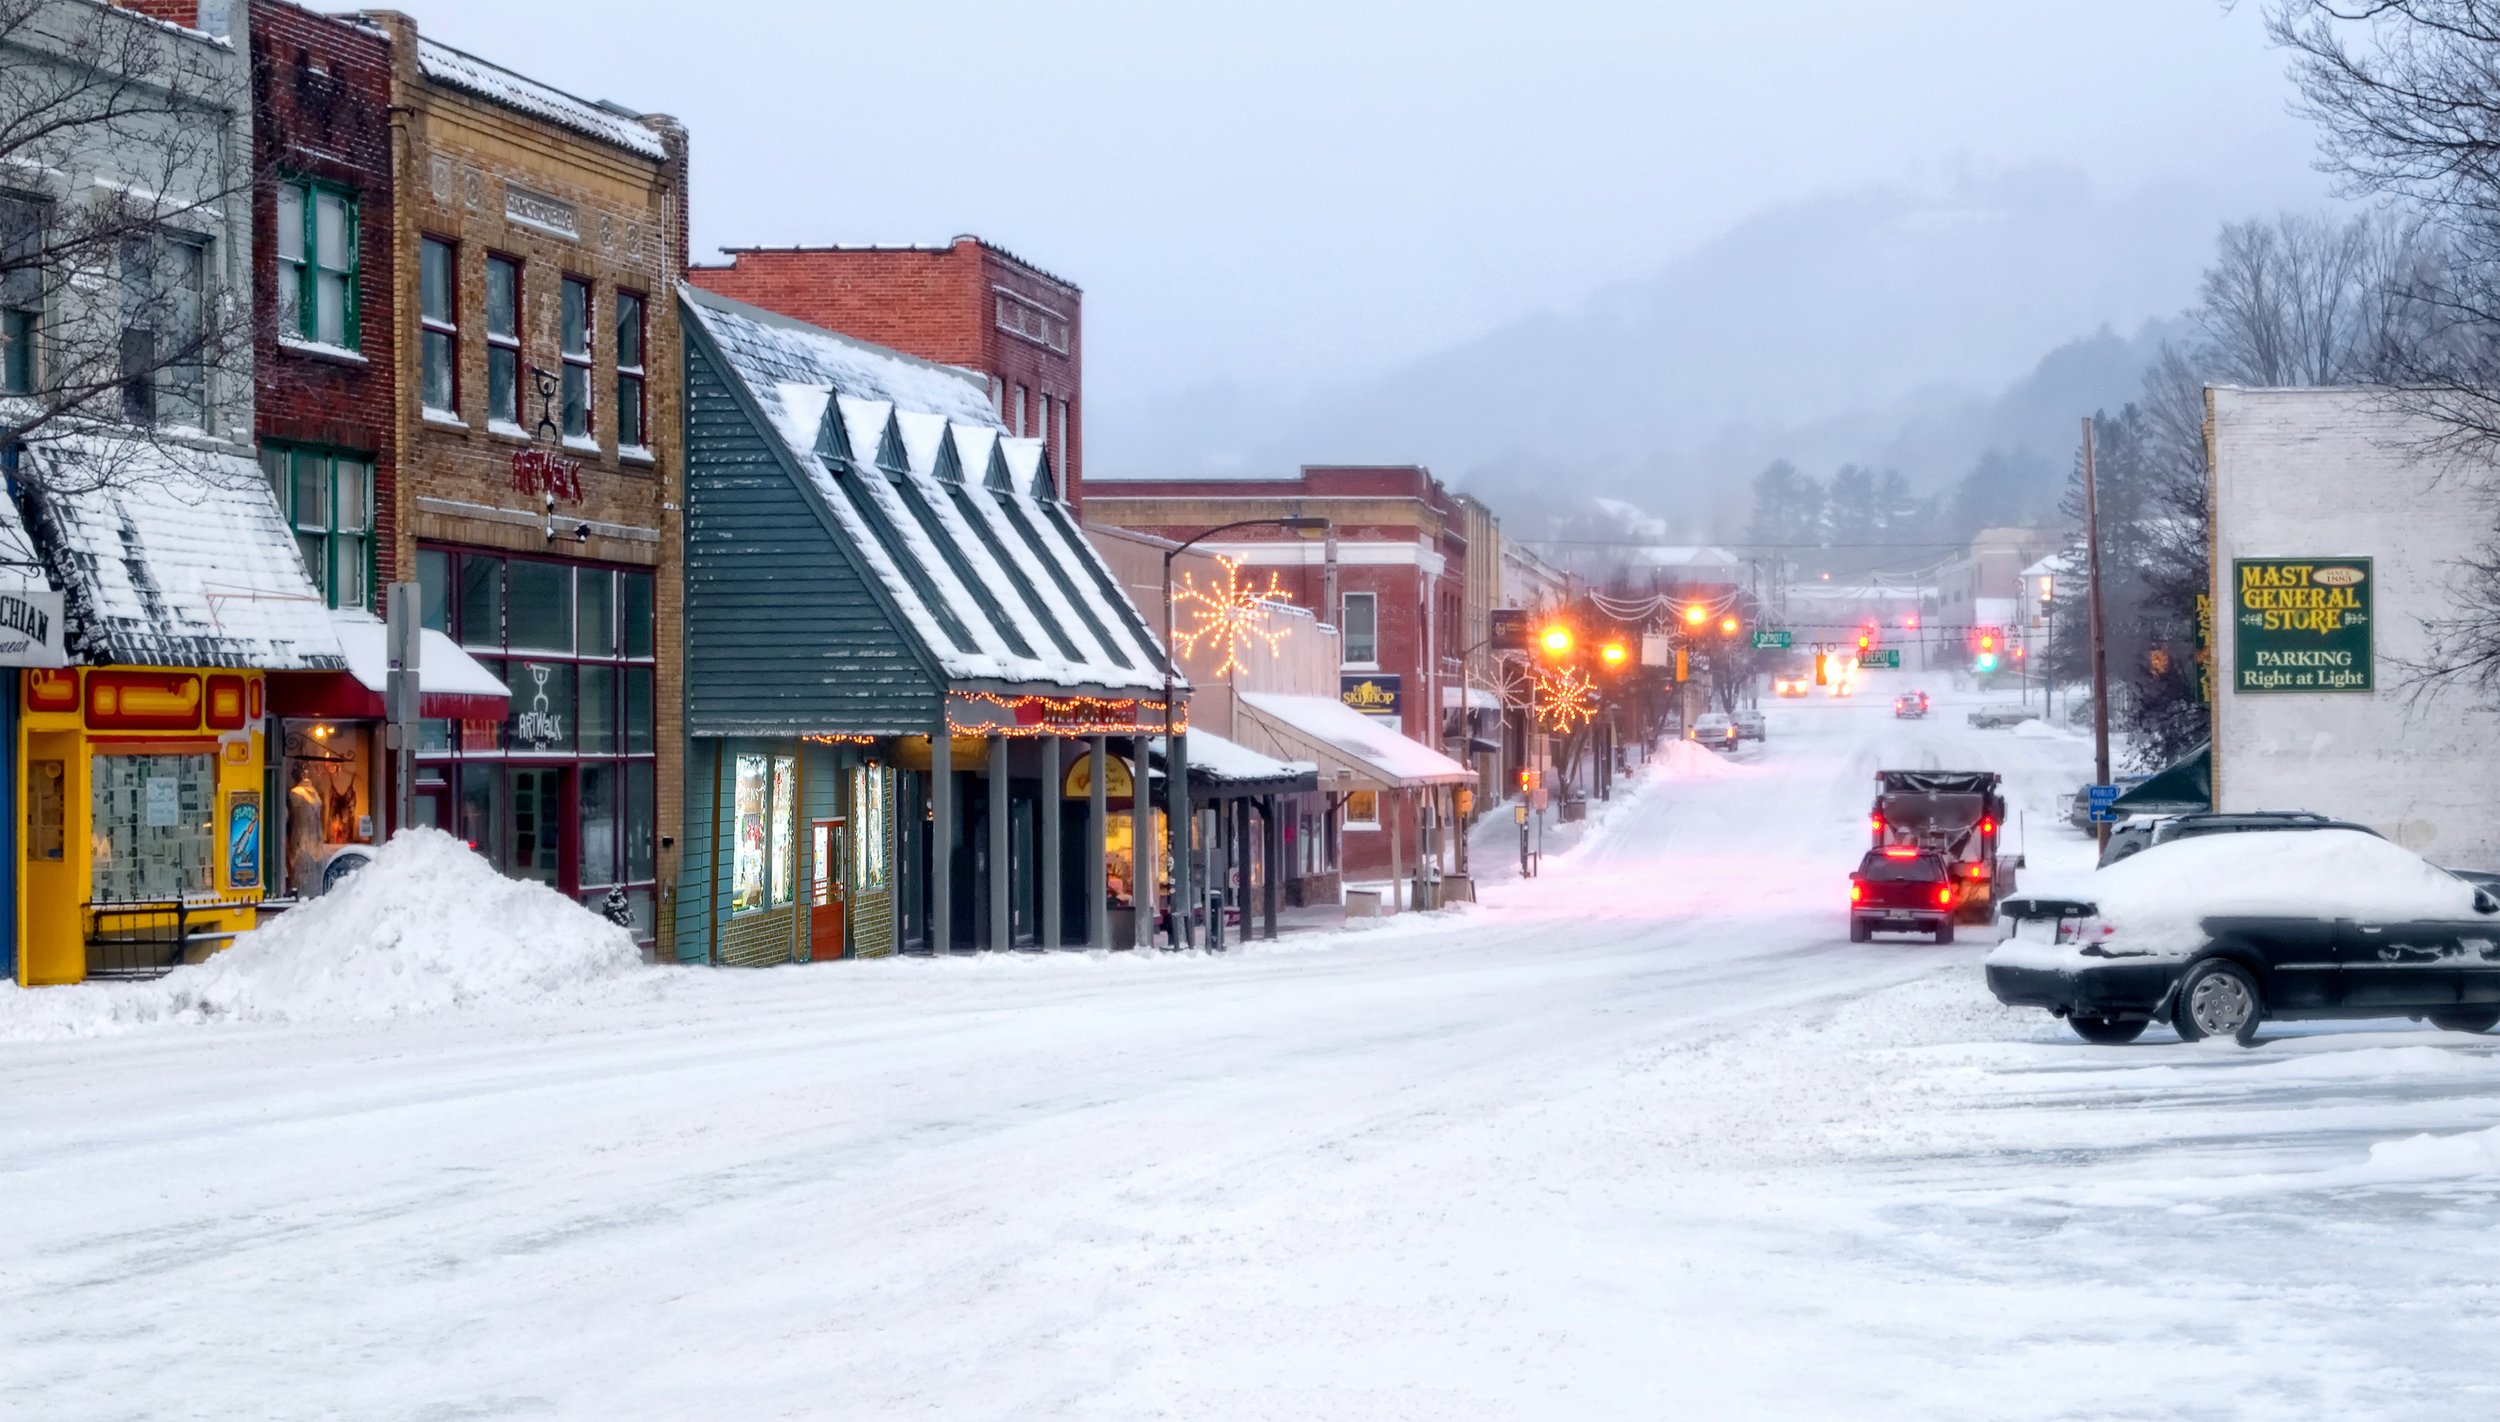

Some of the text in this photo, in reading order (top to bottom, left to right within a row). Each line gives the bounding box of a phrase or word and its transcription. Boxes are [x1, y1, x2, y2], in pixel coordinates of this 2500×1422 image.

[2240, 565, 2314, 592] MAST
[2243, 587, 2361, 609] GENERAL
[2263, 609, 2342, 635] STORE
[1760, 633, 1783, 643] DEPOT
[1865, 651, 1889, 662] DEPOT
[2255, 651, 2352, 666] PARKING
[2243, 670, 2364, 688] Right at Light
